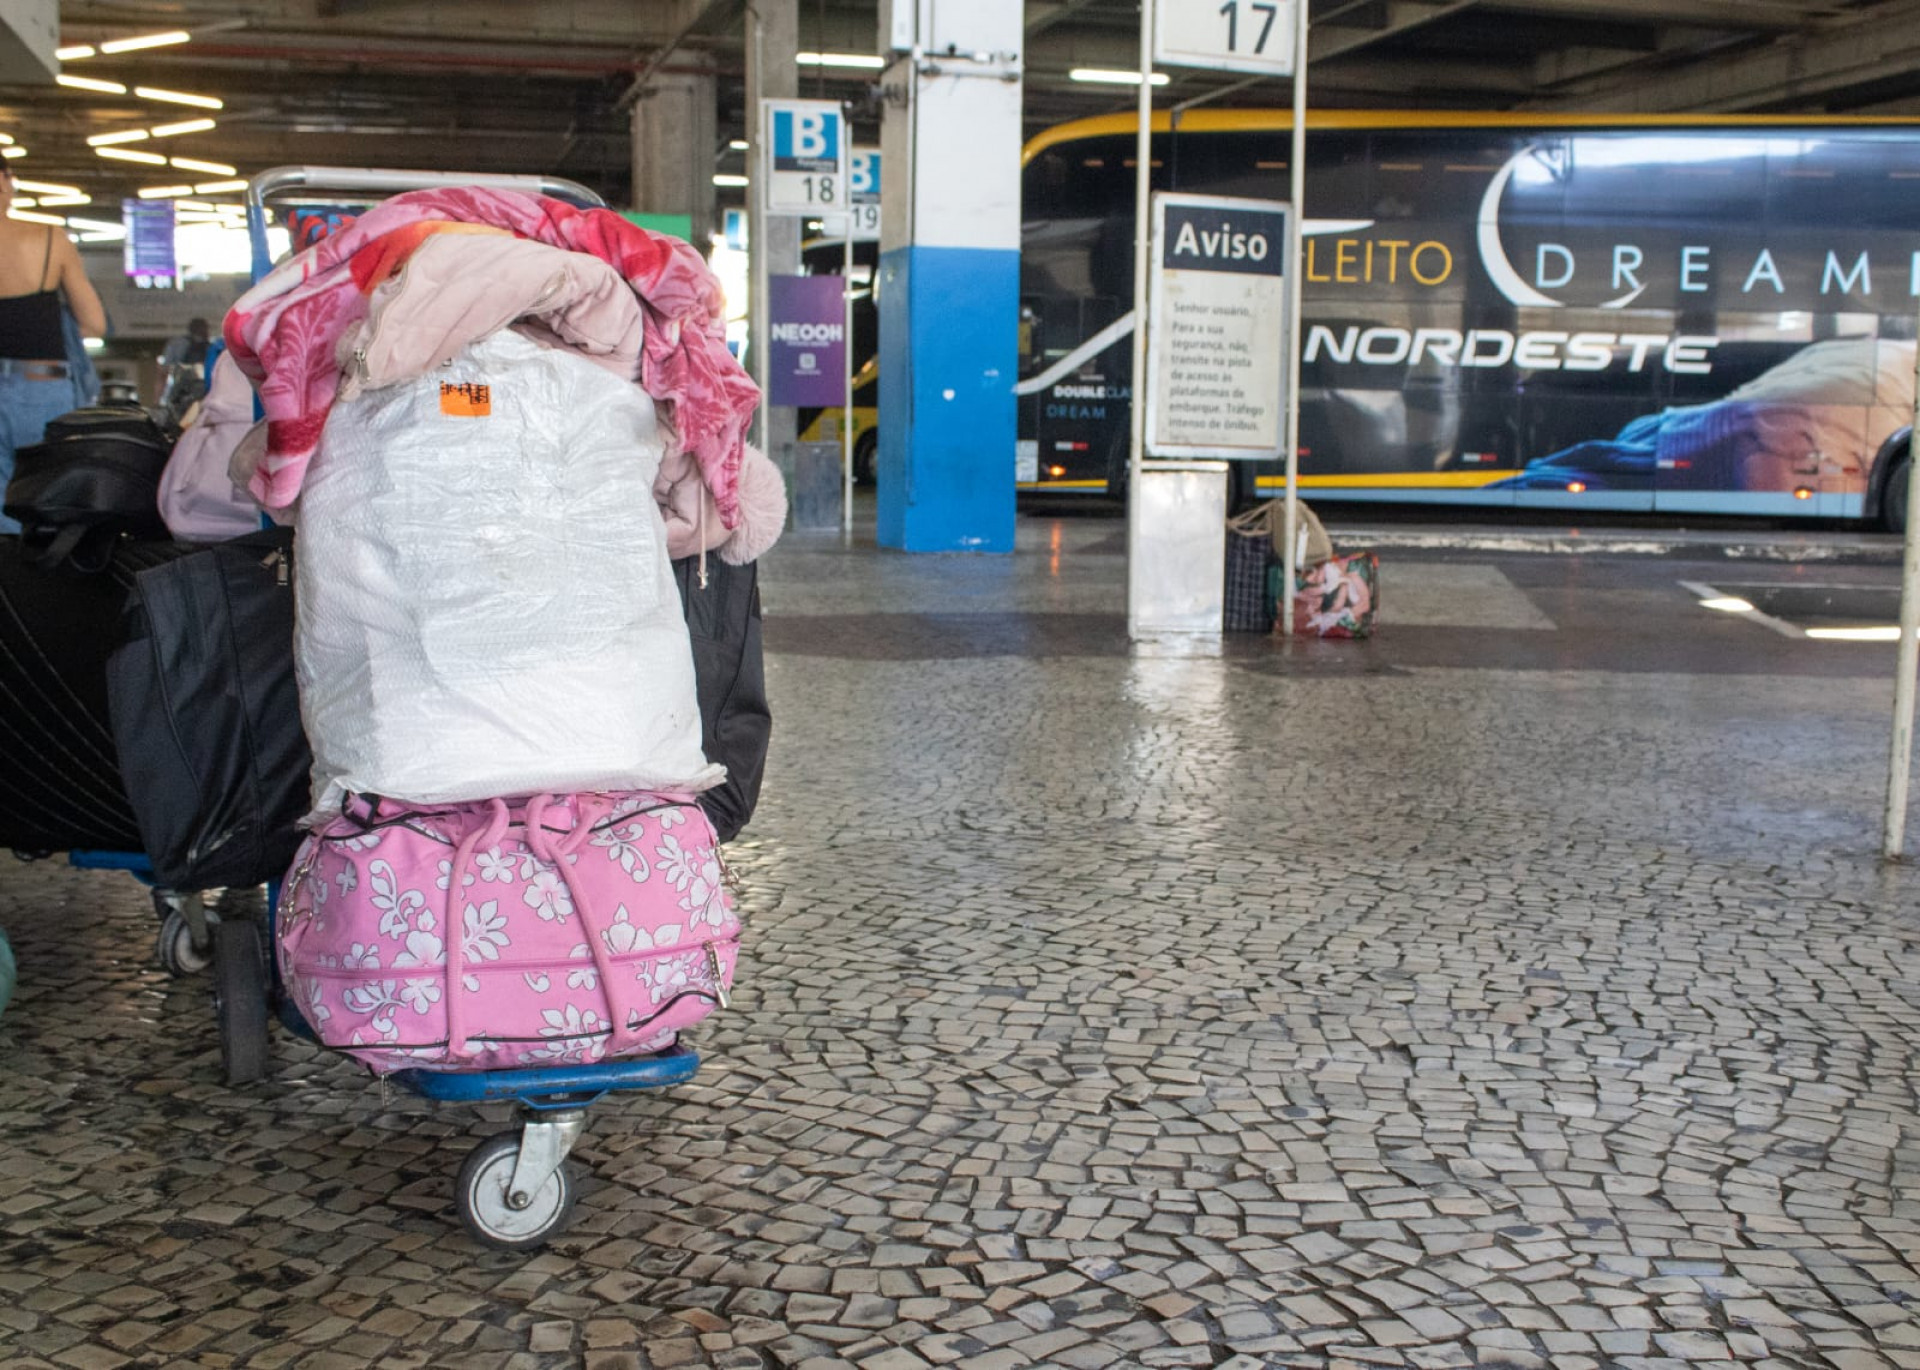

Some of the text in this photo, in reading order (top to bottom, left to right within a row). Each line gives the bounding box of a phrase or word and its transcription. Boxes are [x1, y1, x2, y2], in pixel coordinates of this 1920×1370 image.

[1220, 0, 1277, 54] 17
[792, 111, 826, 157] B
[803, 177, 834, 202] 18
[850, 152, 872, 192] B
[852, 205, 878, 229] 19
[1174, 222, 1268, 261] Aviso
[1306, 239, 1453, 286] LEITO
[772, 323, 843, 341] NEOOH
[1304, 325, 1719, 374] NORDESTE
[1053, 385, 1105, 398] DOUBLE
[1046, 404, 1105, 419] DREAM
